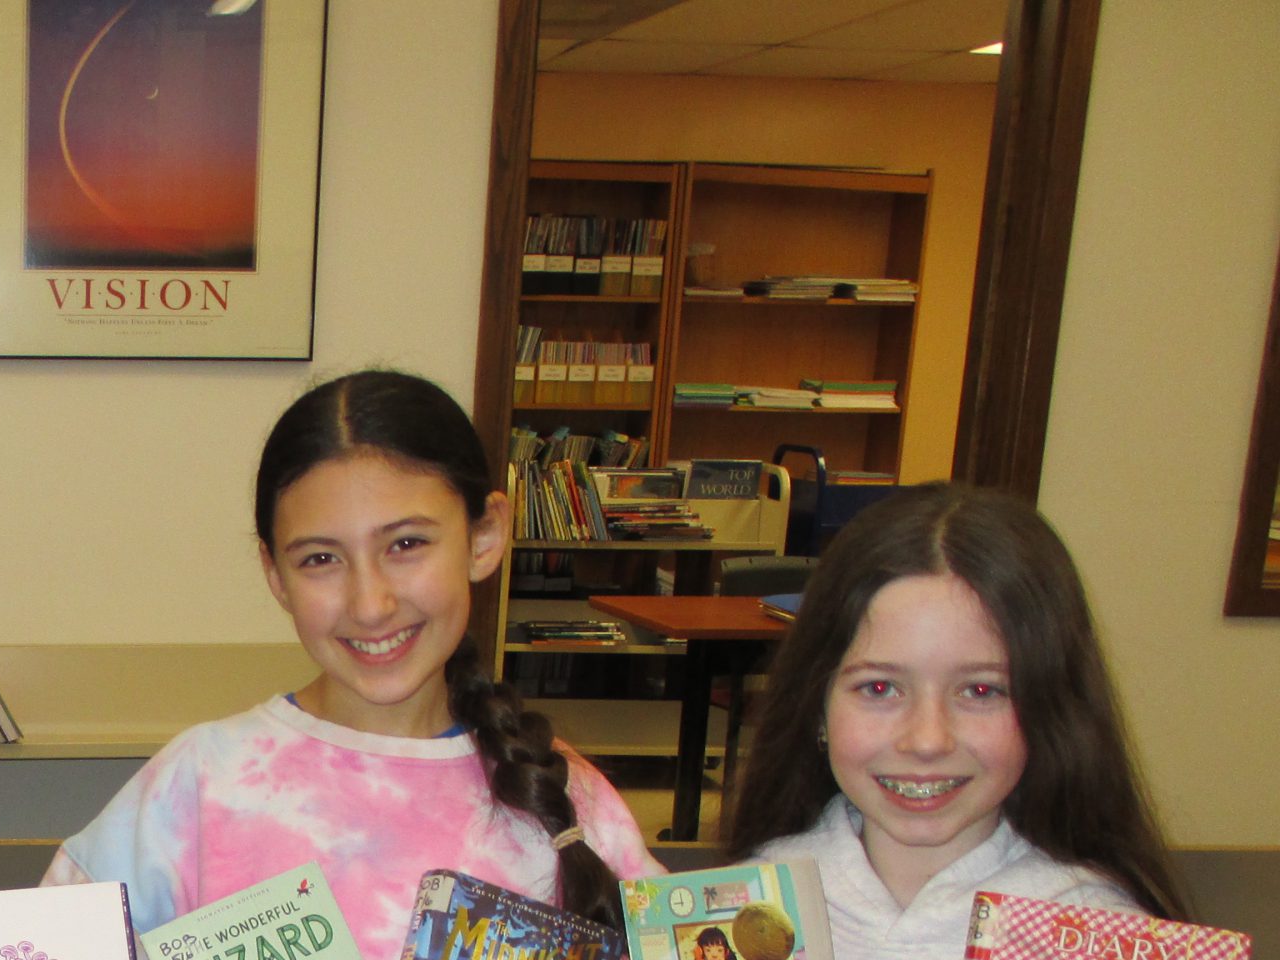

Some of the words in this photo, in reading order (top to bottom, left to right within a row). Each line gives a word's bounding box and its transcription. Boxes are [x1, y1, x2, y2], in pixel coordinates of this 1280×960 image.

[729, 469, 754, 480] TOP
[701, 484, 751, 495] WORLD
[214, 901, 300, 944] WONDERFUL
[471, 886, 485, 896] THE
[498, 896, 512, 906] NEW
[513, 902, 531, 913] YORK
[535, 909, 555, 922] TIMES
[558, 918, 600, 937] BESTSELLER
[159, 934, 197, 957] BOB
